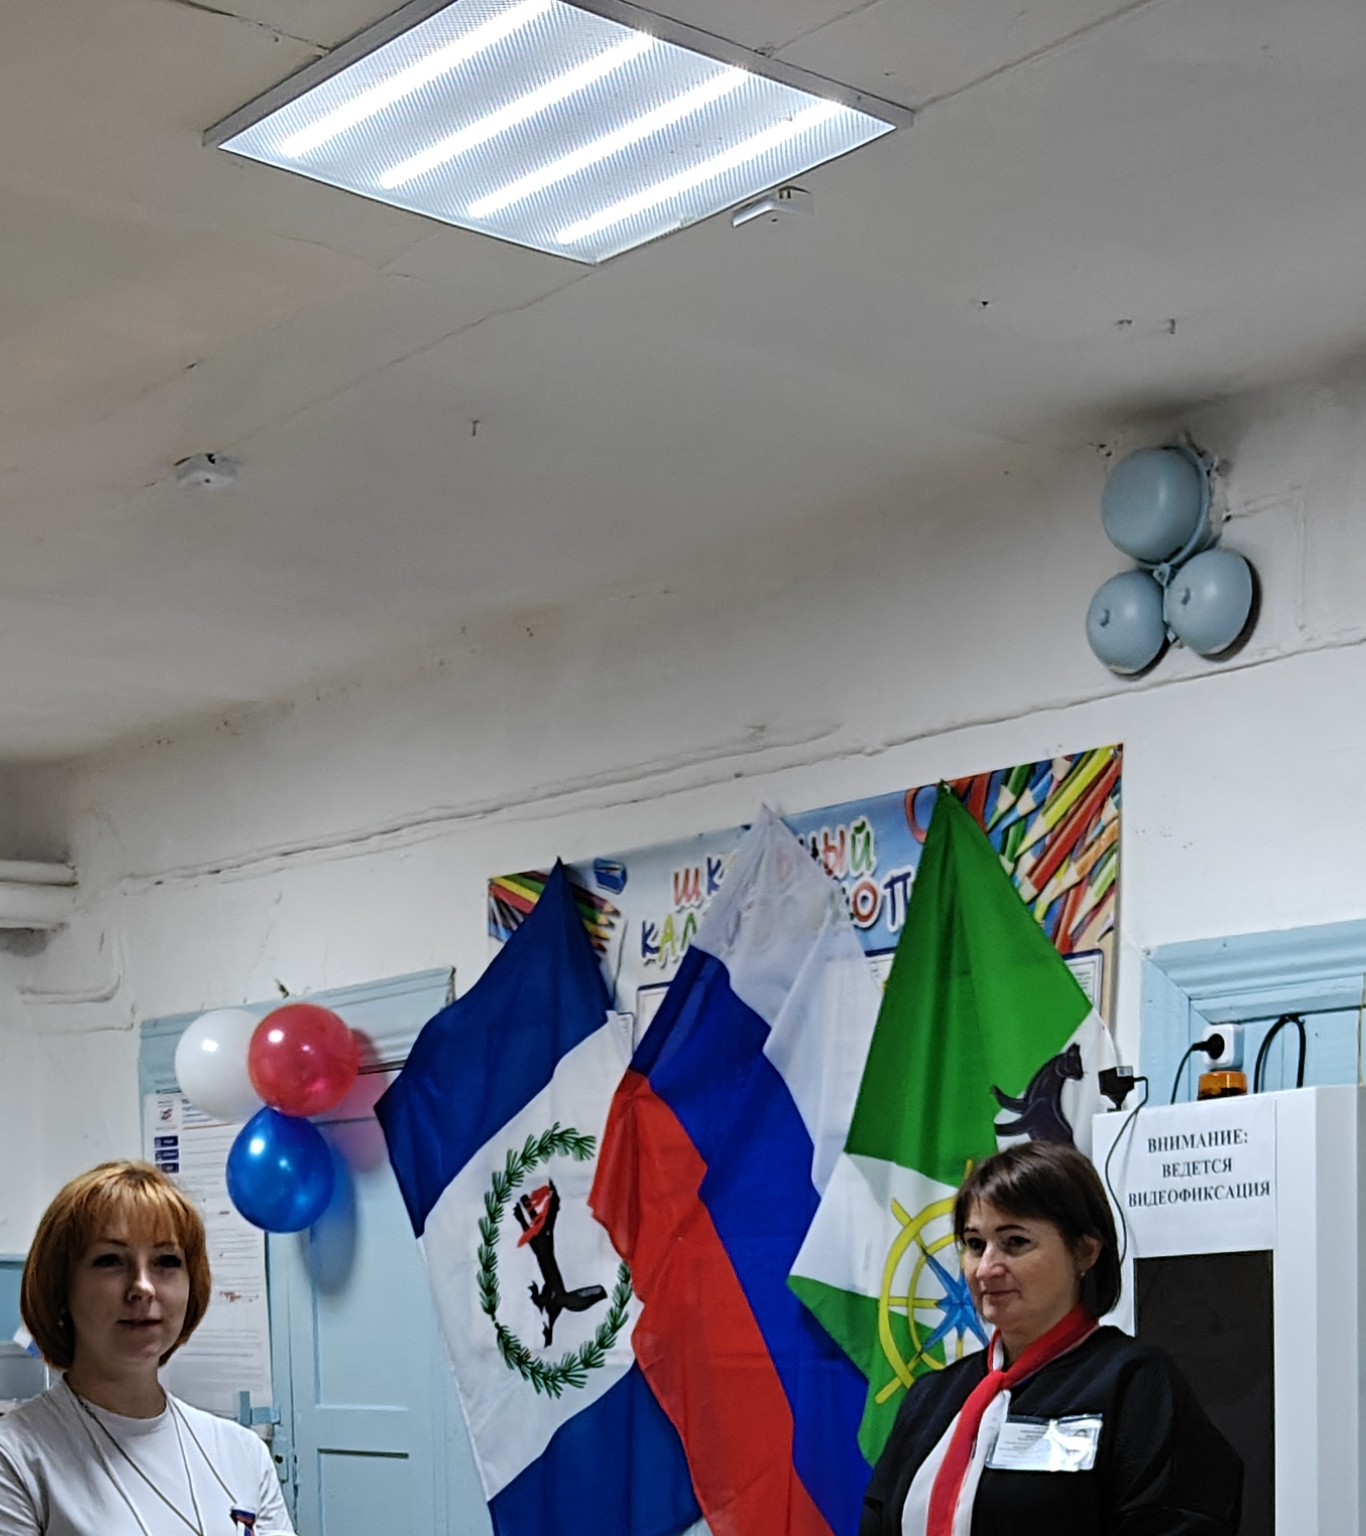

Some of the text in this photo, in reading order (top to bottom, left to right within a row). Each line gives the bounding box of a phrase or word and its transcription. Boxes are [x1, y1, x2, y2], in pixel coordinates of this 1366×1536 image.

[1147, 1128, 1248, 1153] ВНИМАНИЕ:
[1162, 1158, 1233, 1178] ВЕДЕТСЯ
[1128, 1180, 1270, 1207] ВИДЕОФИКСАЦИЯ
